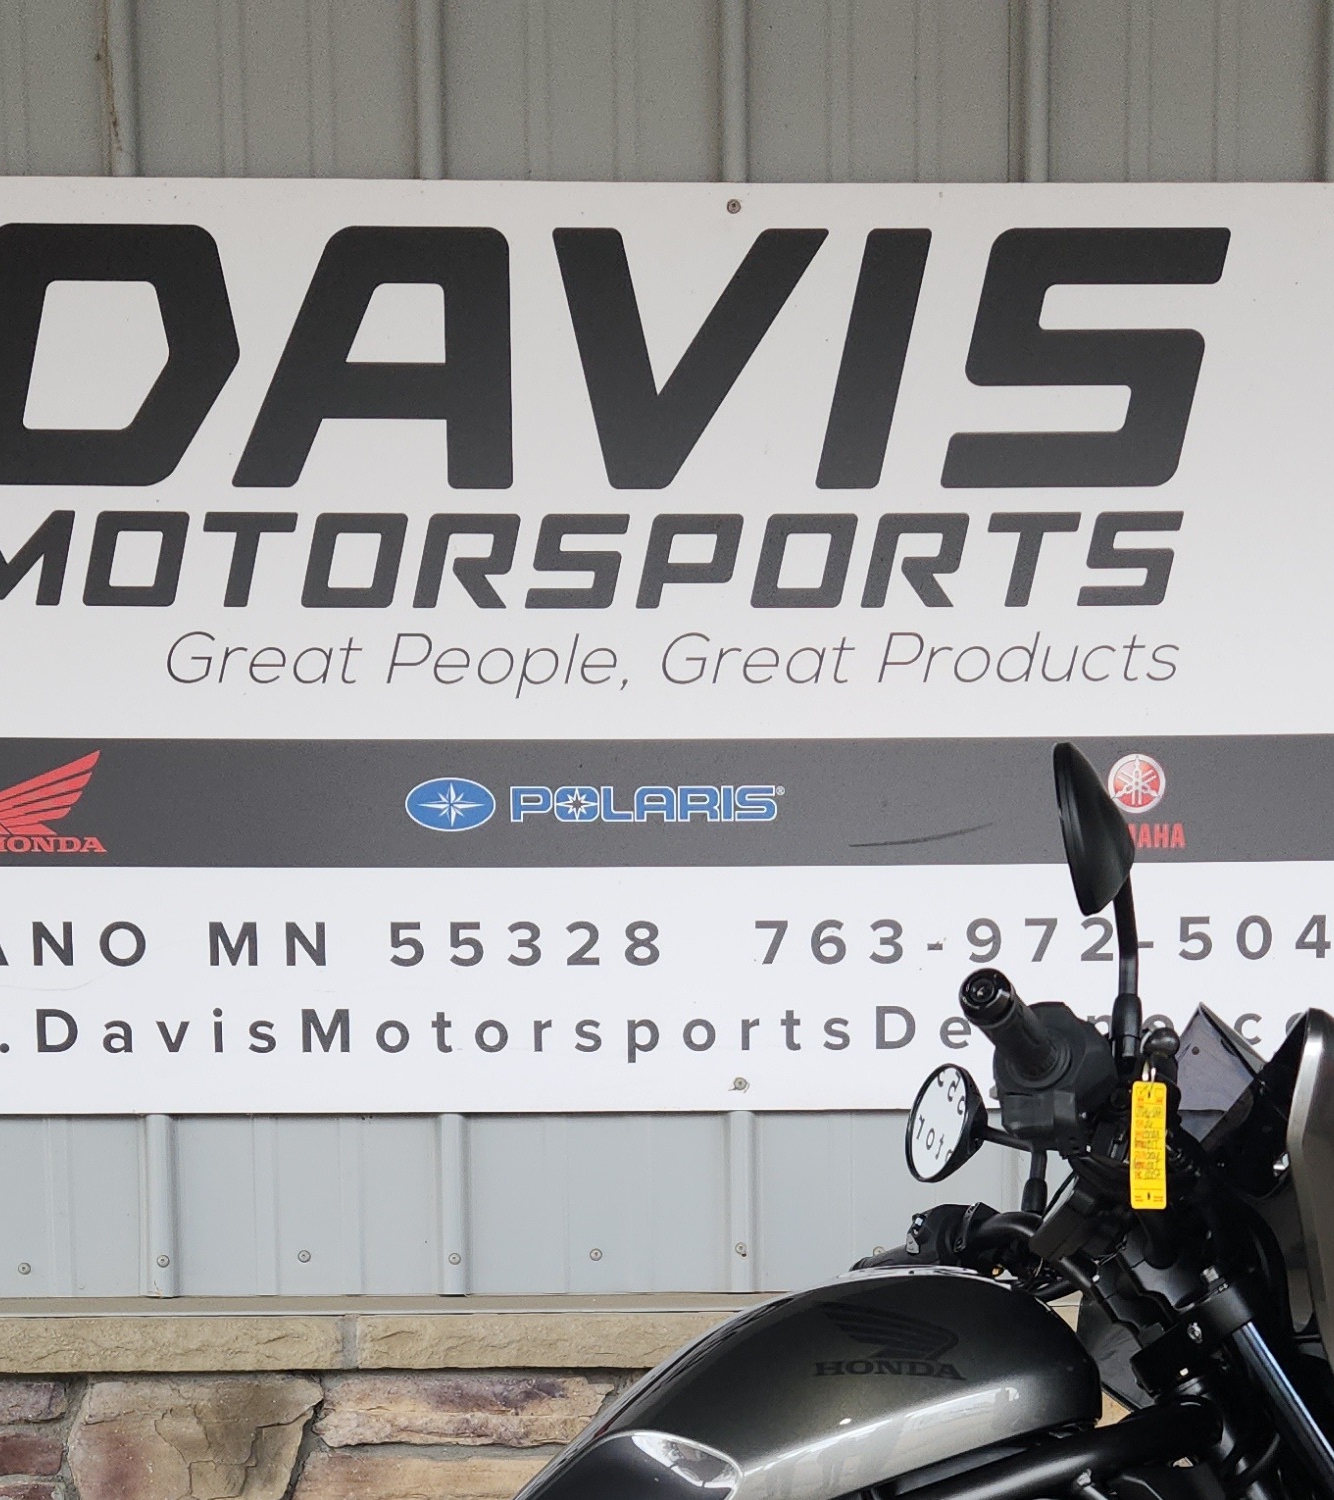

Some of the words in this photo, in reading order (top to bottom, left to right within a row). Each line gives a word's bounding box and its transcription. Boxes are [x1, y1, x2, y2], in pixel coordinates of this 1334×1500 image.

[166, 630, 363, 685] Great
[386, 631, 629, 699] People,
[661, 631, 856, 685] Great
[878, 630, 1180, 684] Products
[510, 785, 778, 822] POLARIS
[1128, 822, 1187, 848] AHA
[208, 920, 328, 967] MN
[390, 918, 661, 967] 55328
[813, 1360, 967, 1381] HONDA
